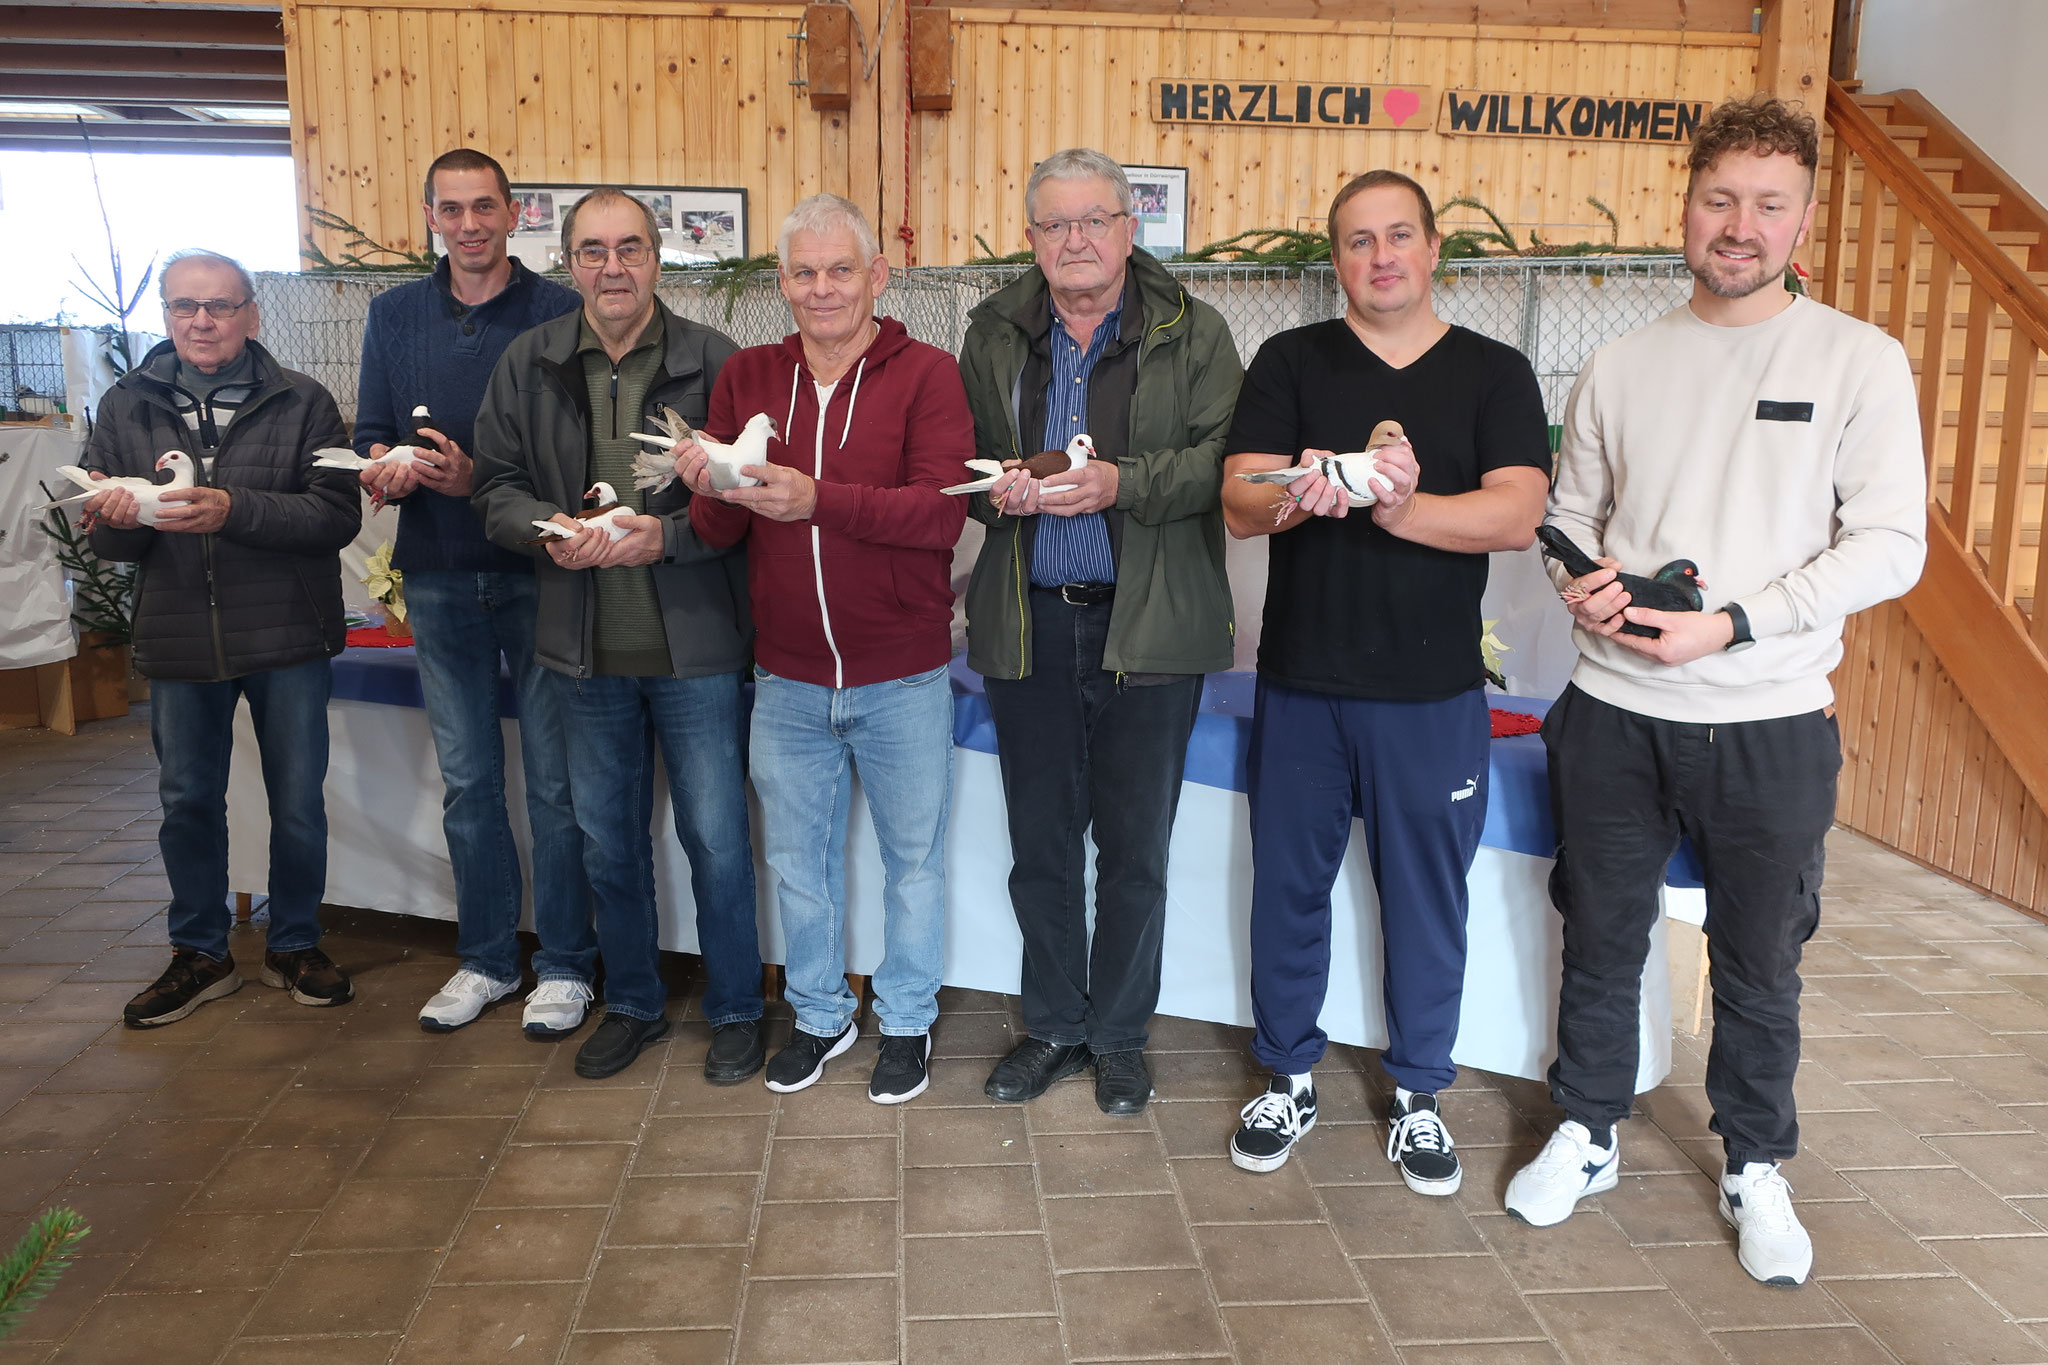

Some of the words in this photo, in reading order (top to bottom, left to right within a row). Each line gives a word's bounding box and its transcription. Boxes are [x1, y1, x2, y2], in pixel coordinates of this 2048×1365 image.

[1160, 83, 1371, 125] HERZLICH
[1448, 92, 1702, 141] WILLKOMMEN
[1451, 786, 1474, 802] PUMA
